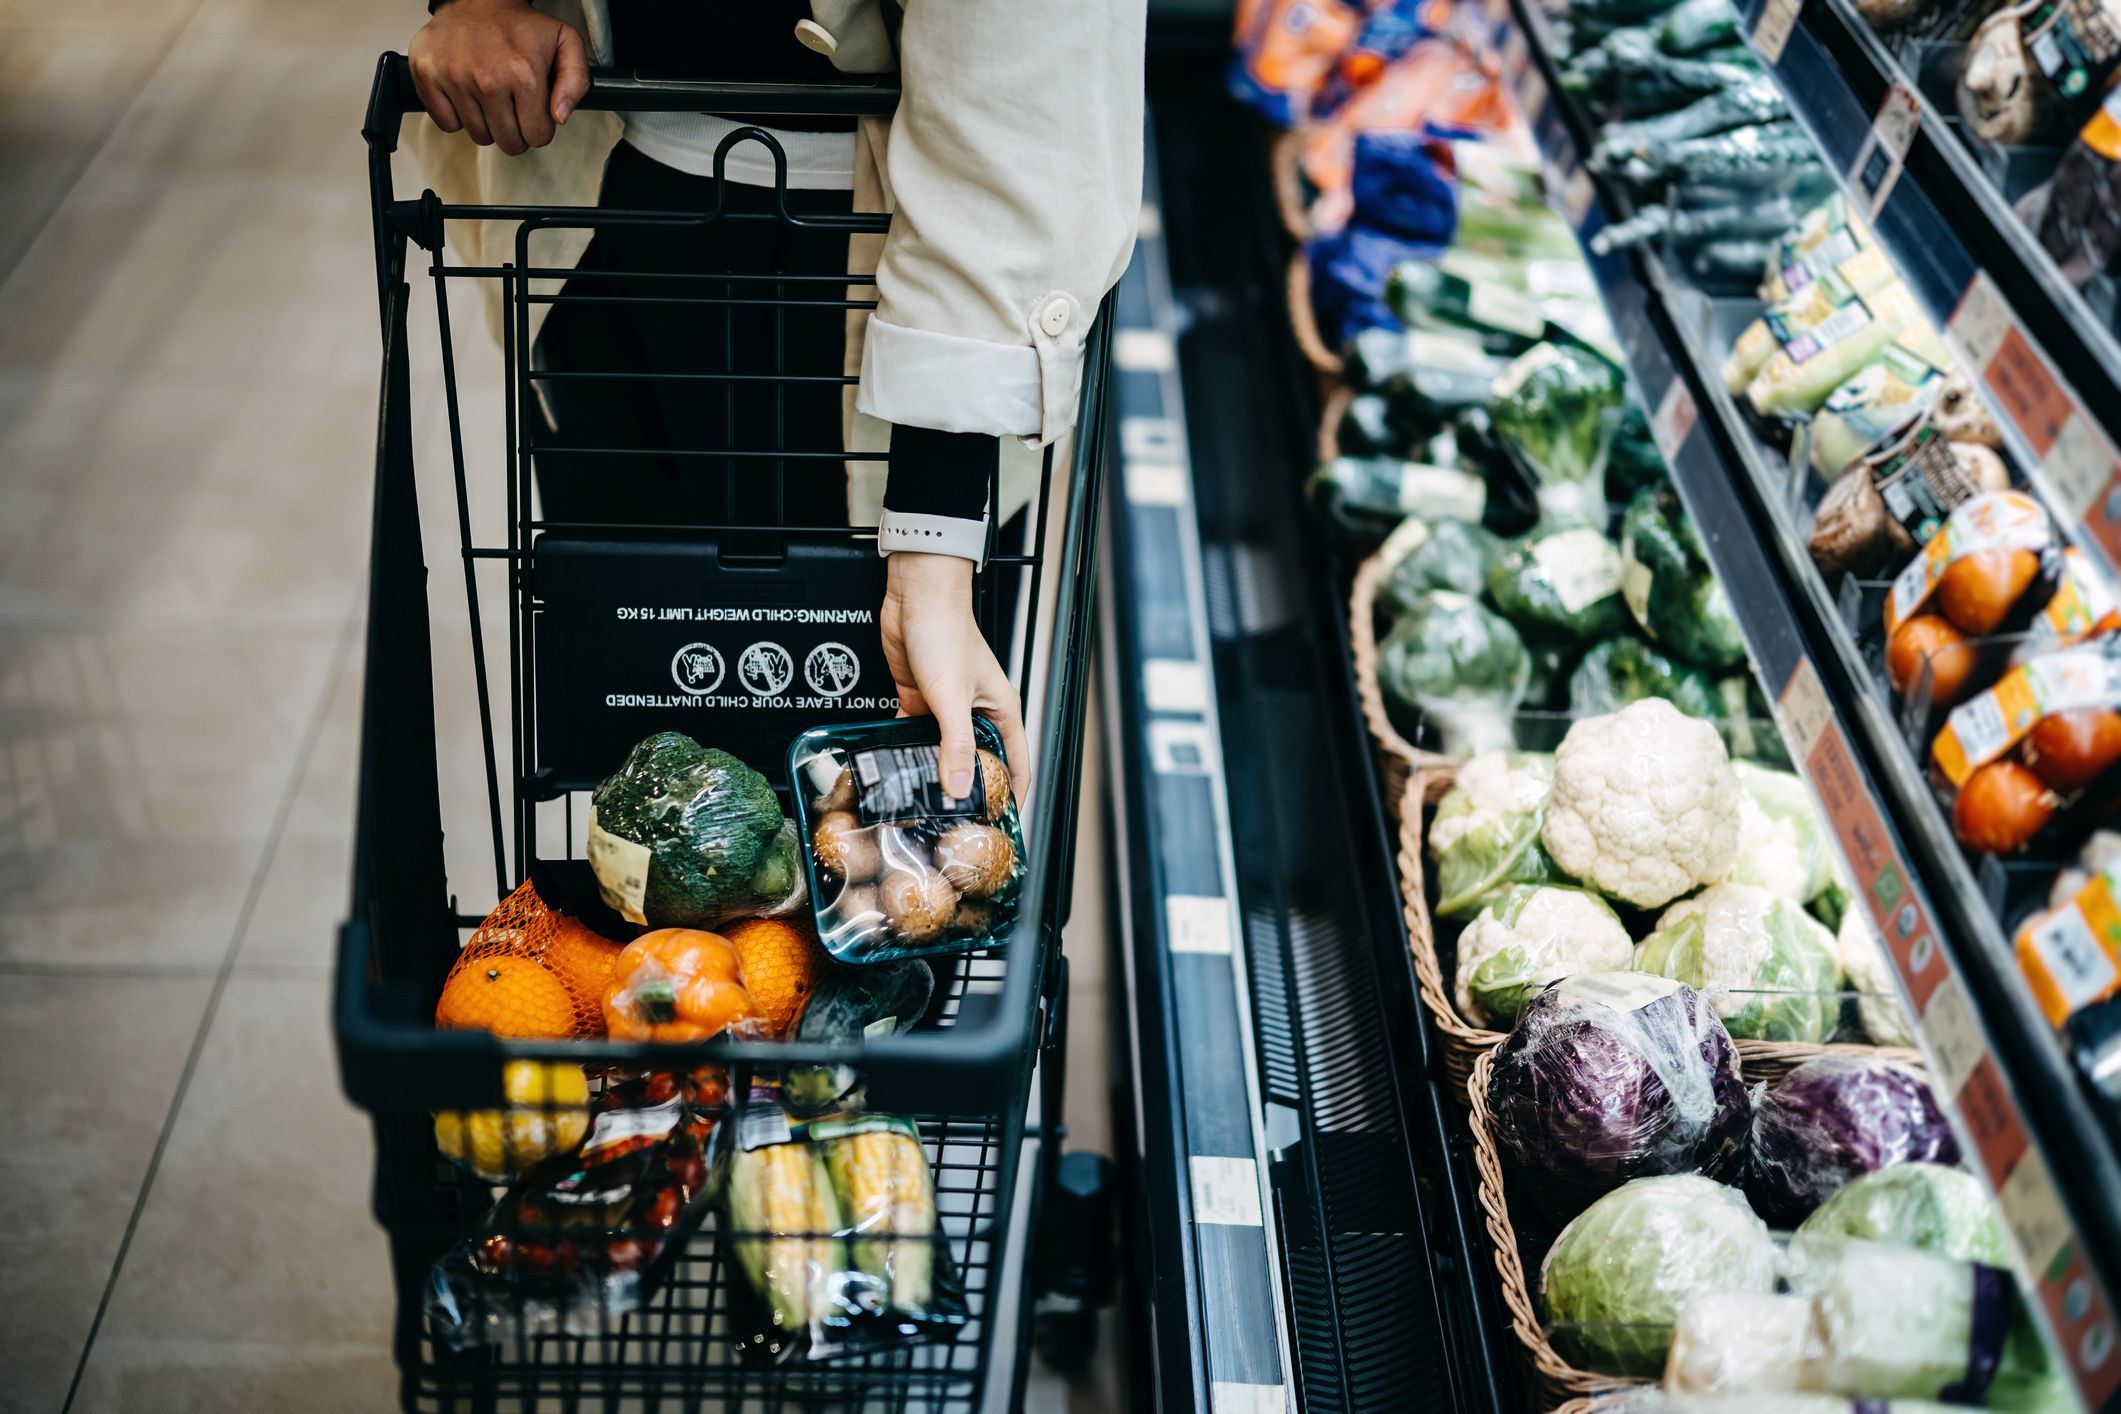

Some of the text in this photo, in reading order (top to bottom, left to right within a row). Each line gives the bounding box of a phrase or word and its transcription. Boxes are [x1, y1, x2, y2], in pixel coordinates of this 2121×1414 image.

[617, 607, 638, 620] KG
[640, 608, 656, 620] 15
[658, 608, 693, 620] LIMIT
[695, 608, 750, 621] WEIGHT
[605, 694, 900, 709] DO NOT LEAVE YOUR CHILD UNATTENDED
